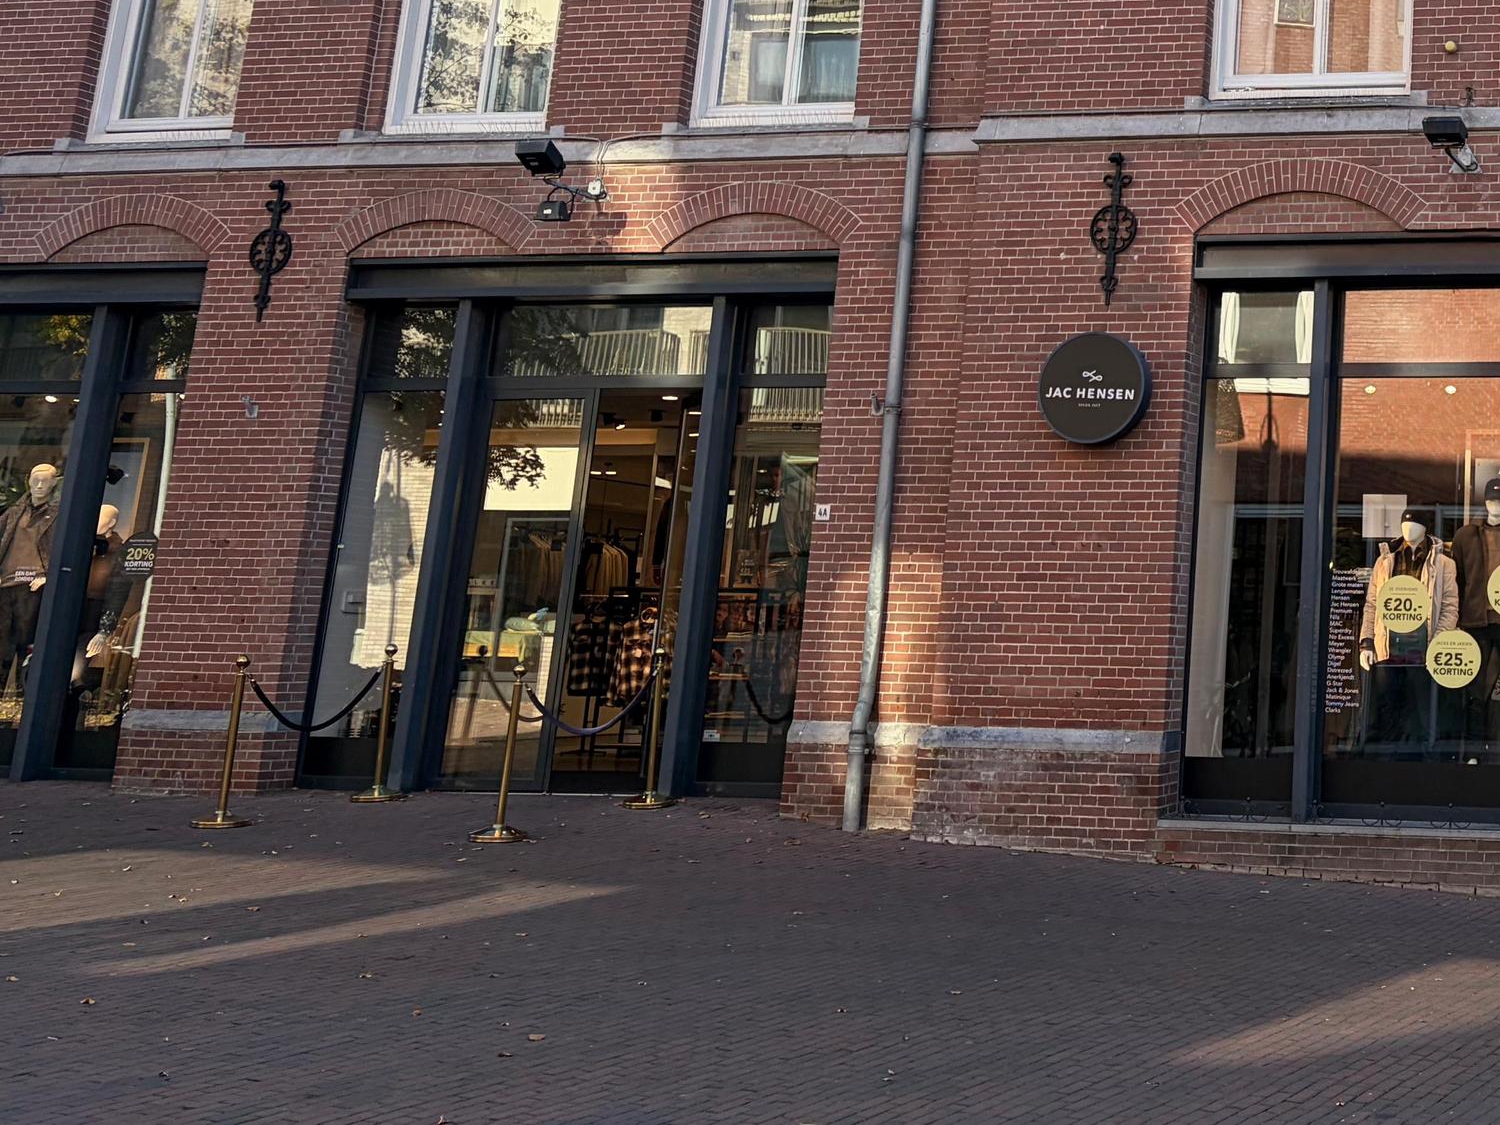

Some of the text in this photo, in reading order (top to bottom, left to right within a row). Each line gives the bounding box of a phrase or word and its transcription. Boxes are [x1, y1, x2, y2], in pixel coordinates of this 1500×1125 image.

[1045, 387, 1135, 400] JAC HENSEN
[818, 508, 827, 516] 4A
[126, 548, 155, 560] 20%
[1383, 597, 1423, 612] €20.-
[1382, 613, 1423, 621] KORTING
[1433, 652, 1474, 667] €25.-
[1433, 667, 1473, 676] KORTING
